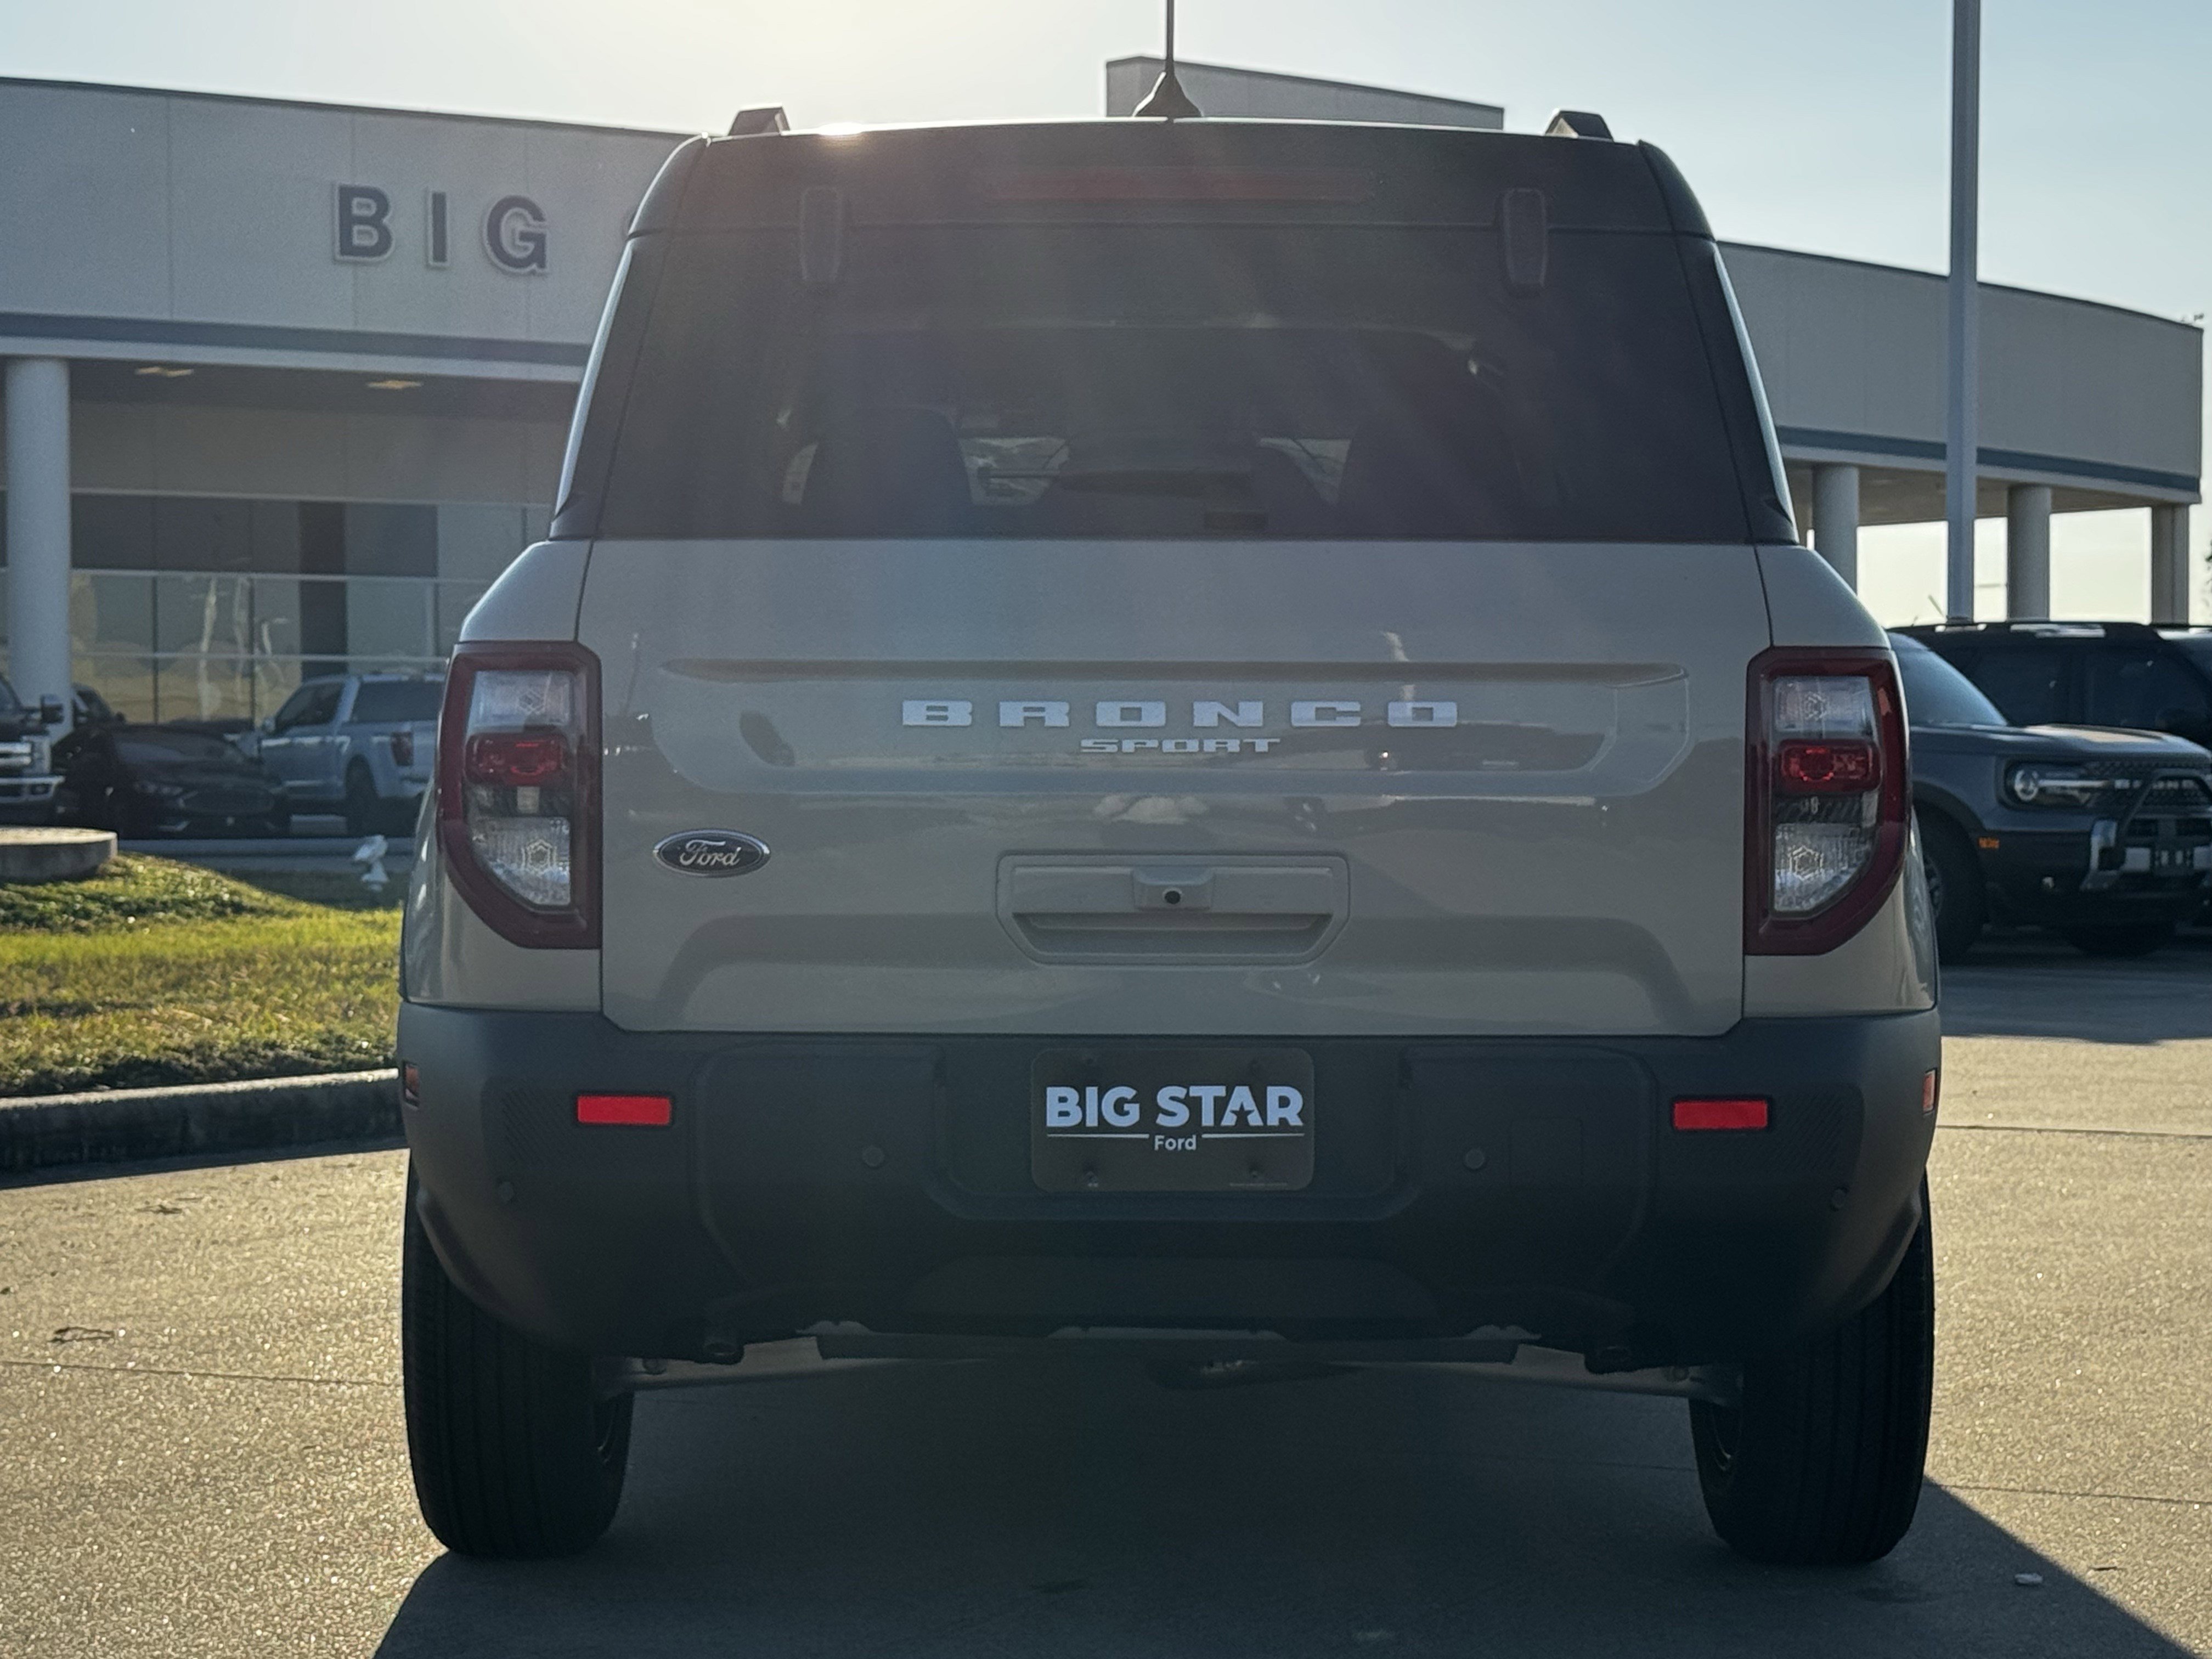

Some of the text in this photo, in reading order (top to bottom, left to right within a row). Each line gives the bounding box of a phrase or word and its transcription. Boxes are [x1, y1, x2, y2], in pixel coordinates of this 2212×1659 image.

[334, 182, 549, 274] BIG
[901, 700, 1458, 728] BRONCO
[1080, 738, 1281, 753] SPORT
[679, 839, 742, 866] Ford
[1046, 1085, 1304, 1127] BIG STAR
[1154, 1134, 1197, 1152] Ford
